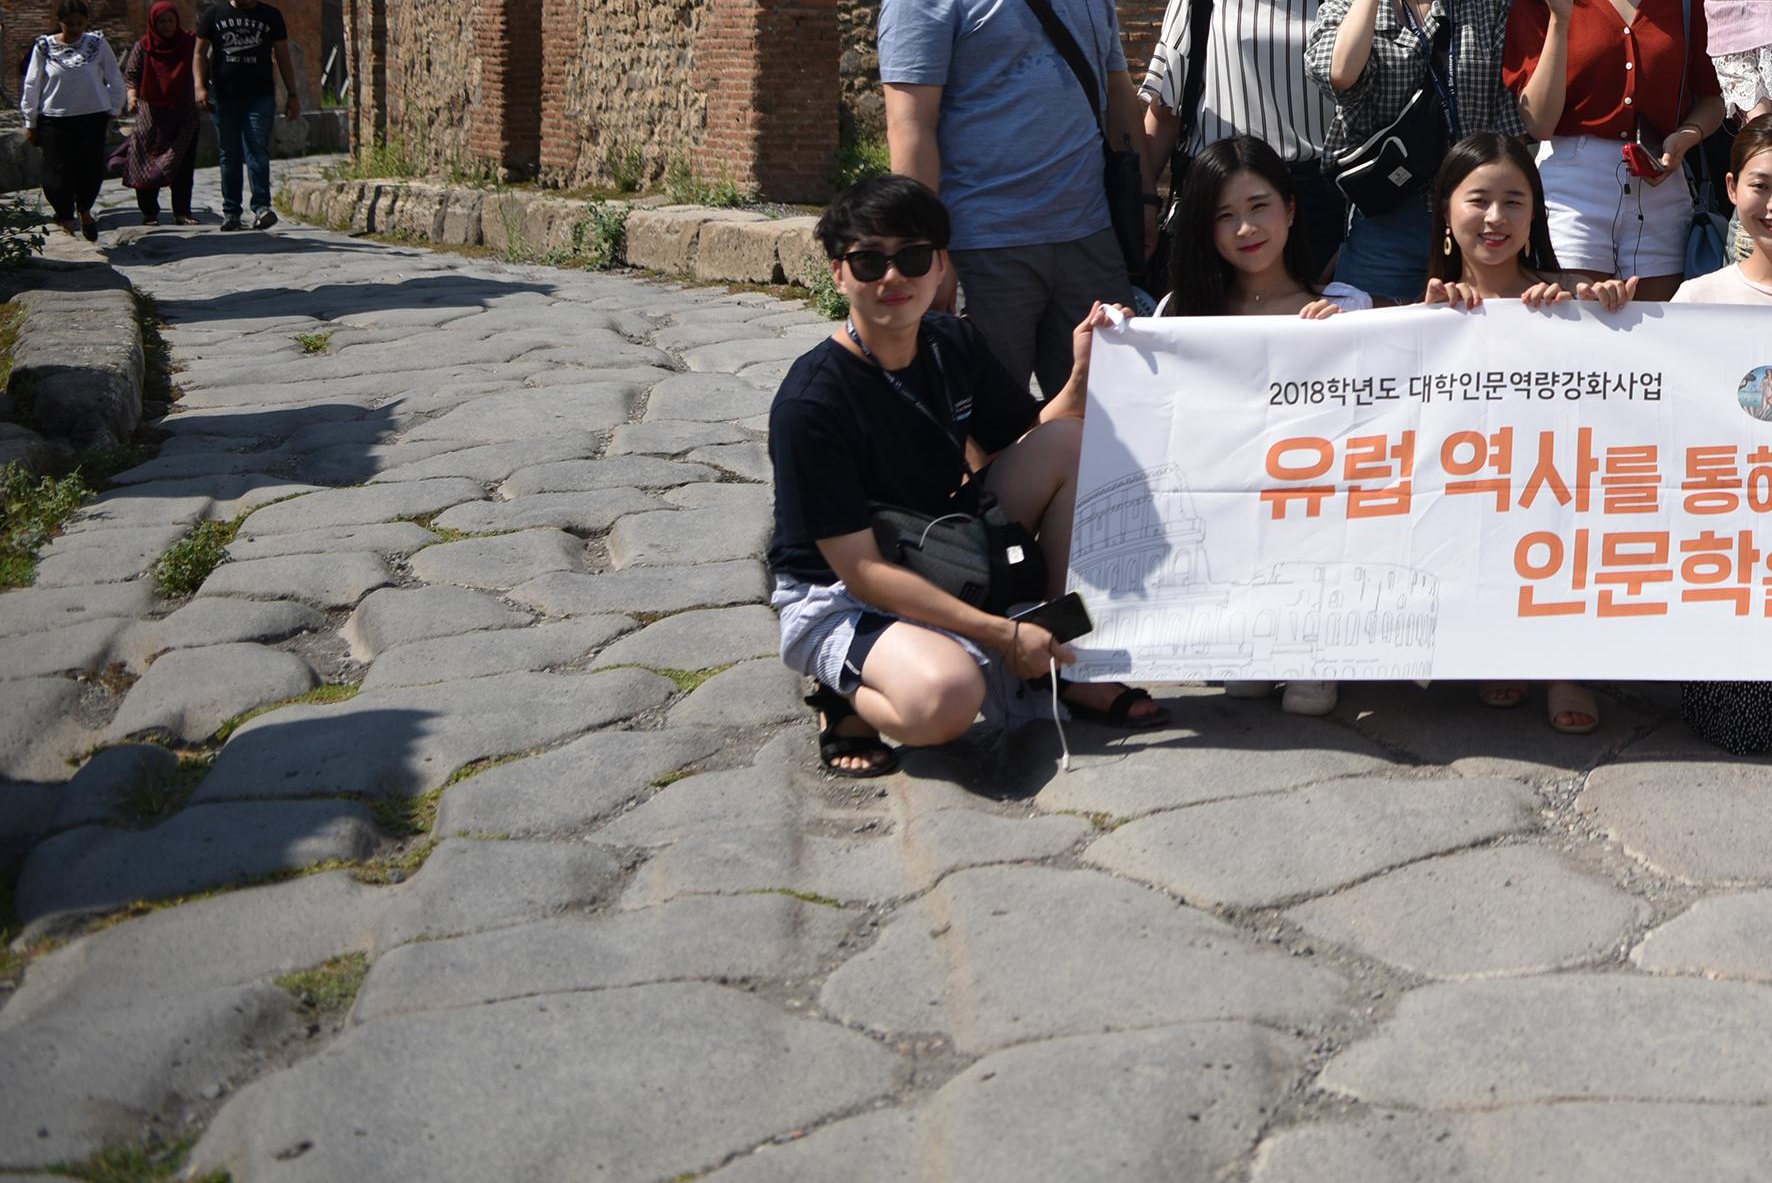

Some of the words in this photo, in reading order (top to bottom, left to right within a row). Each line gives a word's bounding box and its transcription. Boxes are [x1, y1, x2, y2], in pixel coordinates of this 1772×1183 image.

[1268, 376, 1401, 407] 2018학년도
[1408, 371, 1663, 404] 대학인문역량강화사업
[1260, 430, 1417, 520] 유럽
[1440, 426, 1664, 516] 역사를
